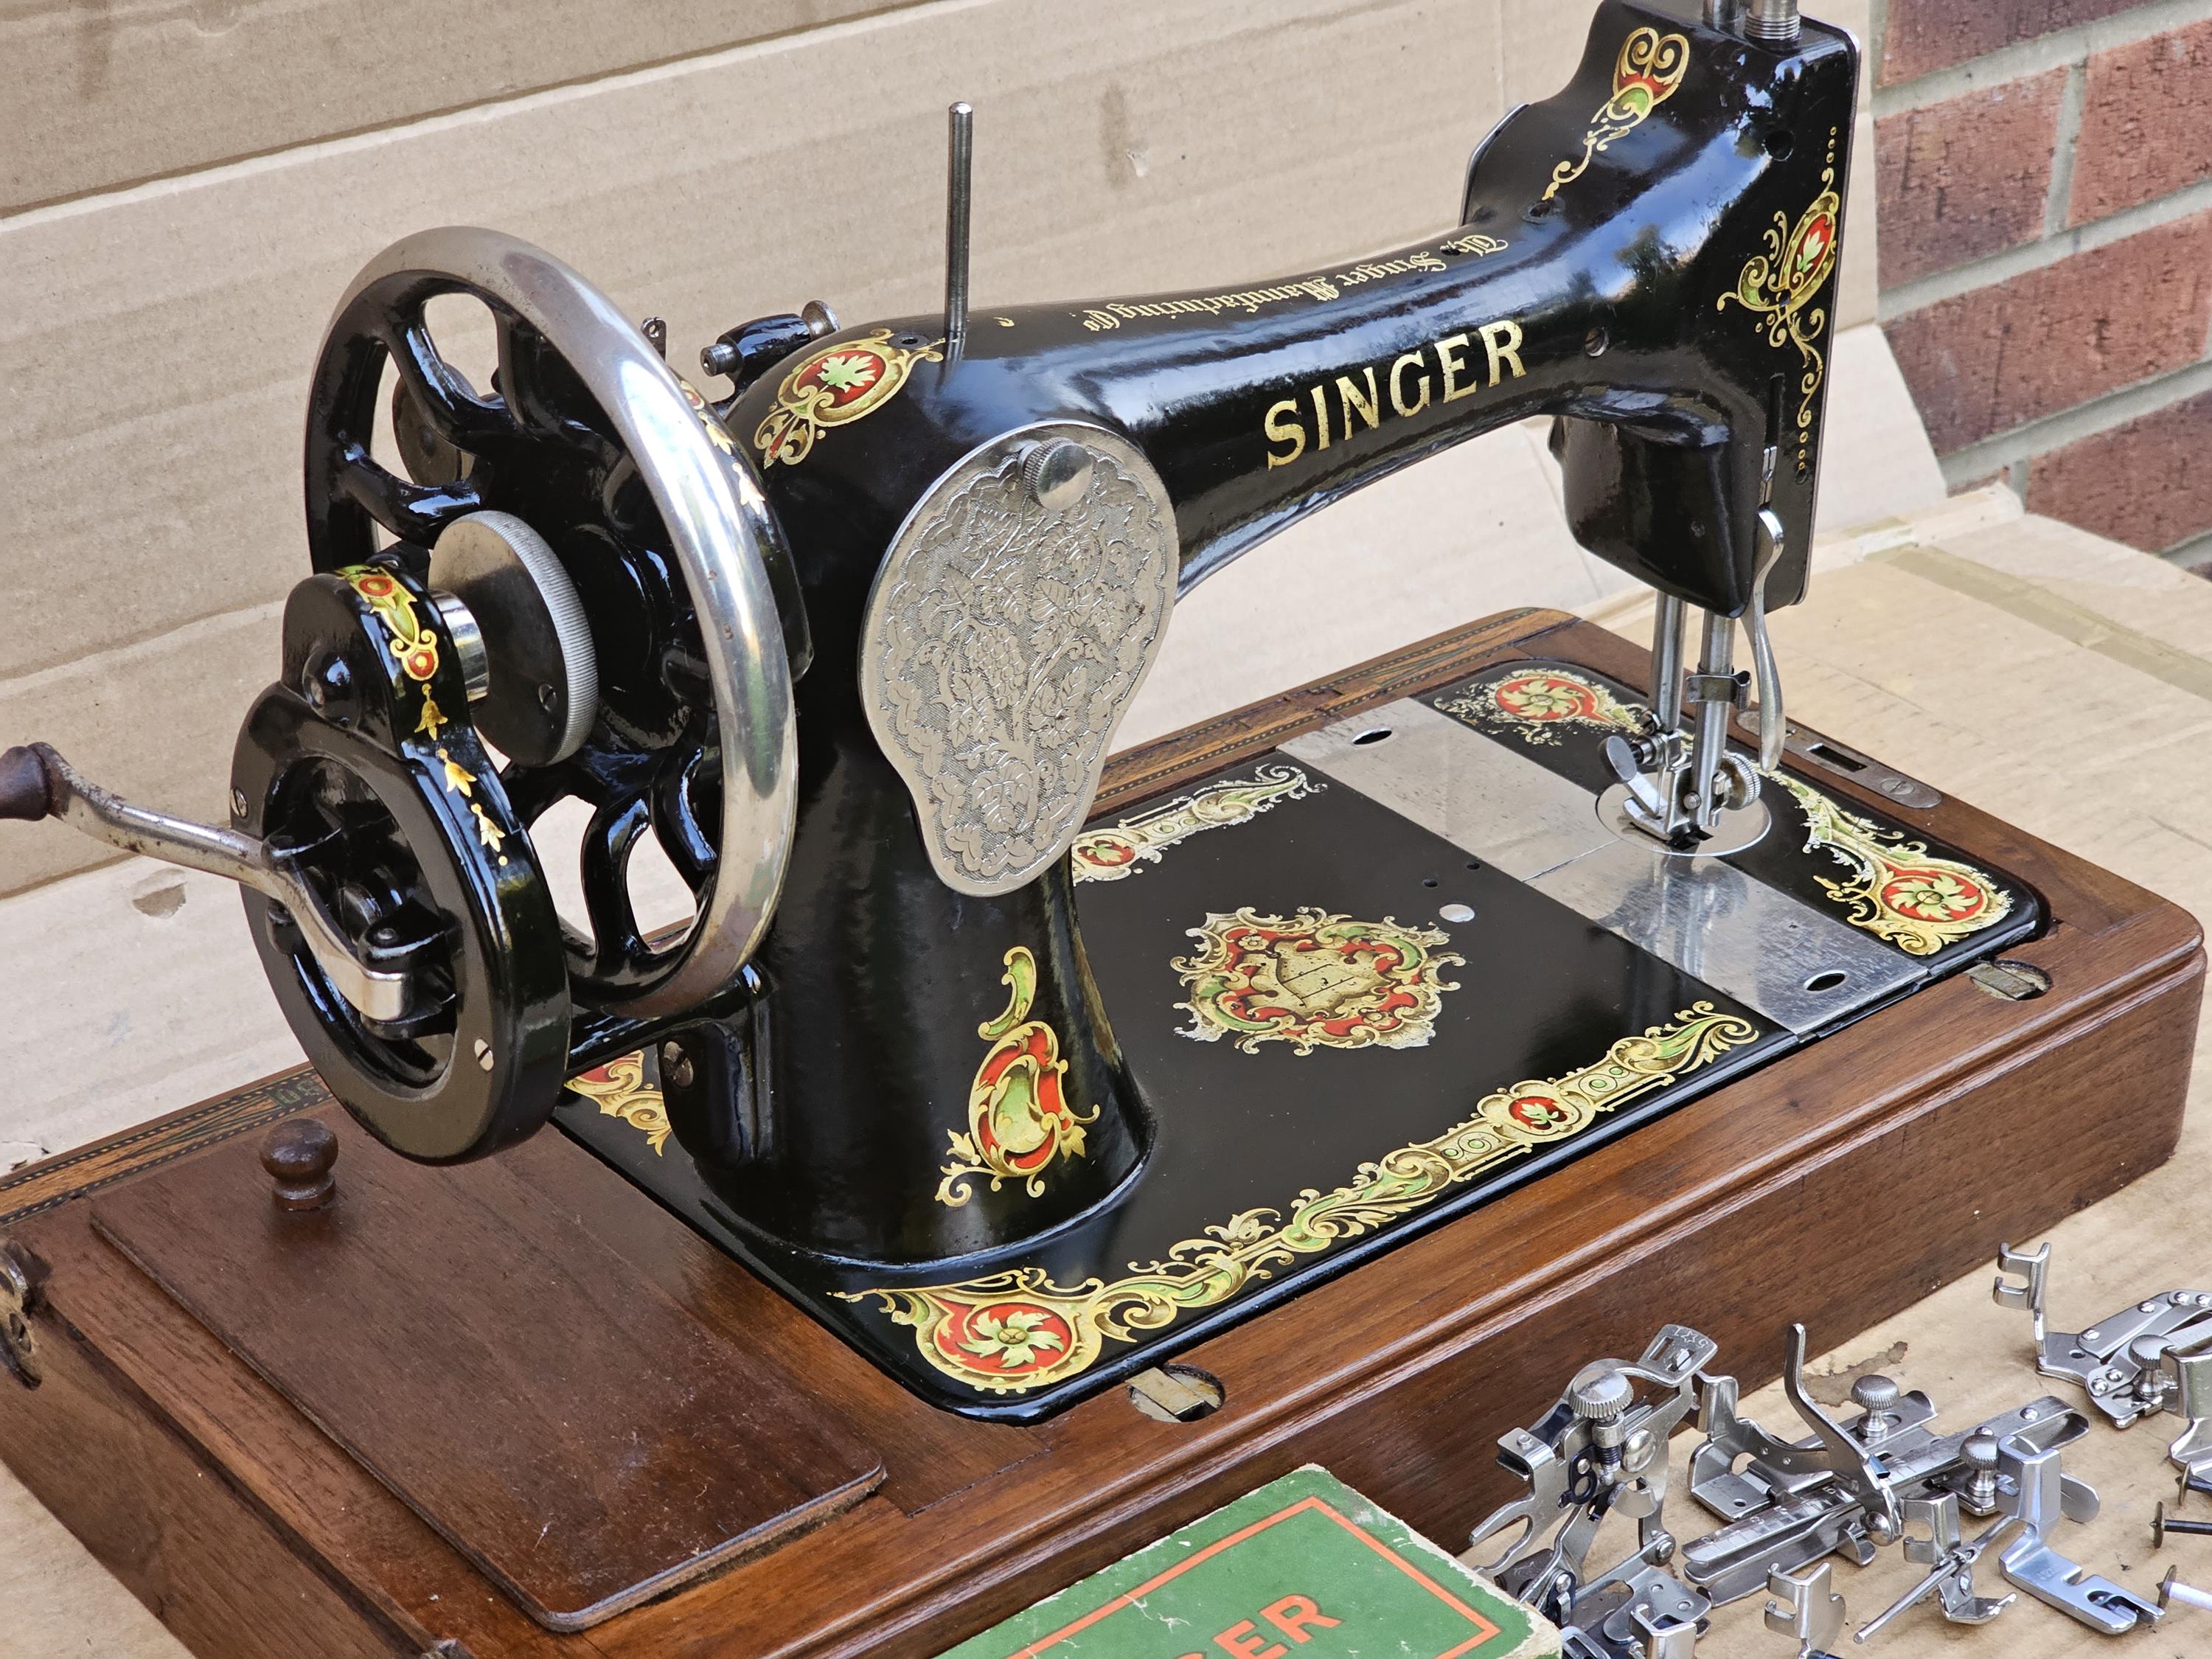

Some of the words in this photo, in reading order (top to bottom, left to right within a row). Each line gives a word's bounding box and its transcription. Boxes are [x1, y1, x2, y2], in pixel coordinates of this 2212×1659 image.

[1335, 251, 1447, 286] Singer
[1106, 276, 1340, 319] Manufacturing
[1264, 320, 1526, 471] SINGER
[1175, 1593, 1344, 1659] ER
